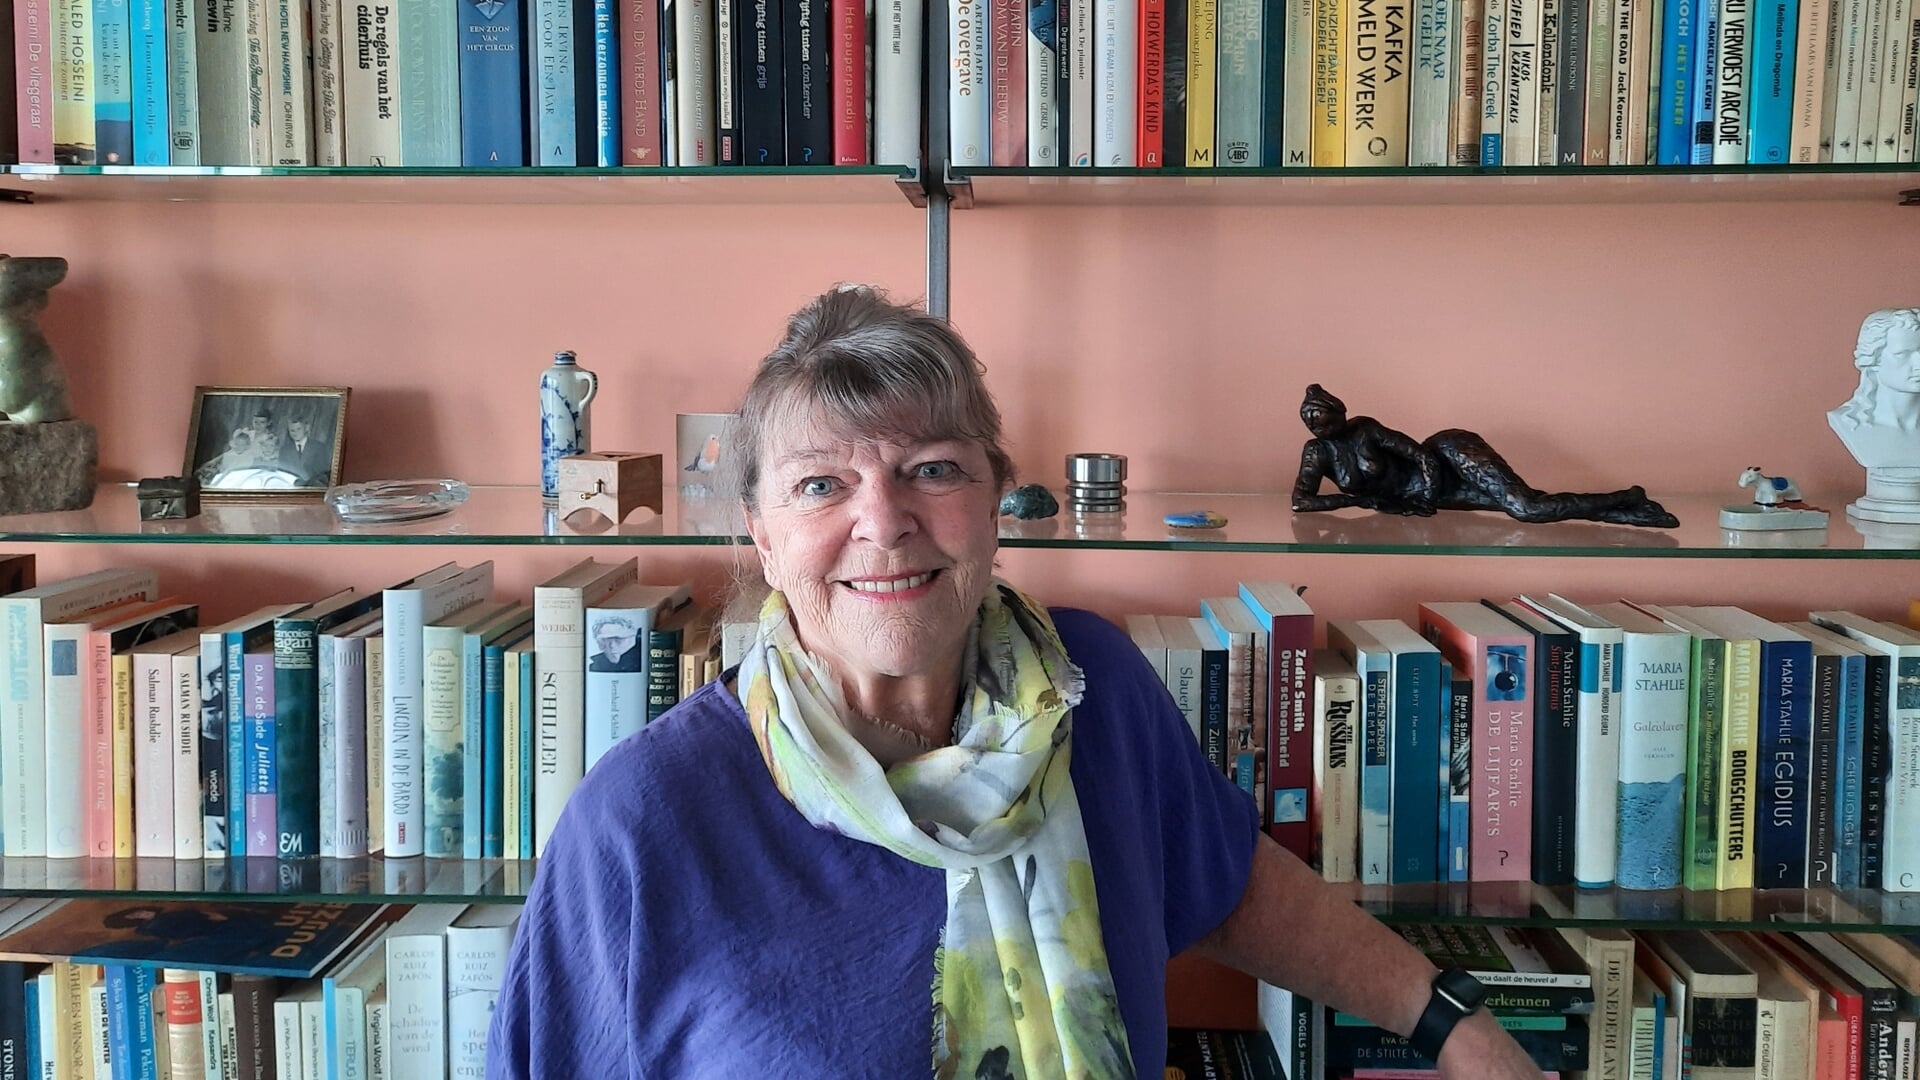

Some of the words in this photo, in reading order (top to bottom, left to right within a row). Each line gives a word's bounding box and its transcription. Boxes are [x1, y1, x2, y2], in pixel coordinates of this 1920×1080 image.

[280, 5, 288, 30] HOTEL
[375, 6, 389, 23] De
[486, 25, 510, 33] ZOON
[598, 14, 610, 33] Het
[844, 7, 855, 29] Het
[975, 4, 983, 50] ARTHUR
[1009, 8, 1022, 47] JAPIN
[1107, 19, 1115, 30] UIT
[1203, 9, 1214, 40] JONG
[1317, 1, 1326, 50] ANDERE
[1620, 11, 1629, 30] THE
[1775, 4, 1786, 37] Melinda
[59, 13, 68, 66] schitterende
[281, 31, 290, 51] NEW
[357, 5, 373, 69] ciderhuis
[373, 26, 390, 67] regels
[757, 30, 766, 63] tinten
[801, 29, 811, 61] tinten
[892, 24, 901, 39] WITTE
[892, 41, 901, 54] HART
[997, 22, 1007, 52] VAN
[1061, 27, 1068, 36] De
[1106, 34, 1115, 48] HET
[1384, 6, 1404, 83] KAFKA
[1420, 15, 1432, 68] GELUK
[1488, 15, 1501, 52] Zorba
[1776, 40, 1782, 50] en
[1911, 38, 1920, 55] VAN
[29, 43, 42, 61] De
[954, 20, 972, 96] overgave
[997, 56, 1008, 73] DE
[1106, 49, 1114, 69] RAAM
[1146, 11, 1160, 96] HOKWERDA'S
[1433, 36, 1446, 80] NAAR
[1568, 35, 1577, 91] KELLENDONK
[1618, 34, 1628, 64] ROAD
[1676, 44, 1686, 72] HET
[1706, 21, 1715, 76] MAKKELIJK
[1722, 19, 1745, 88] VERWOEST
[72, 36, 85, 101] HOSSEINI
[111, 65, 121, 94] bergen
[282, 51, 292, 96] HAMPSHIRE
[378, 70, 388, 94] van
[598, 39, 609, 96] verzonnen
[756, 65, 767, 89] grijs
[843, 33, 856, 130] pauperparadijs
[974, 53, 983, 84] JAPIN
[1040, 47, 1048, 97] SCHITTEREND
[1317, 54, 1325, 103] MENSEN
[1487, 54, 1500, 78] The
[1521, 51, 1531, 81] NIKOS
[1617, 71, 1627, 93] Jack
[1806, 68, 1815, 87] VAN
[1908, 56, 1917, 88] KOOTEN
[27, 67, 43, 128] vliegeraar
[60, 69, 68, 100] zonnen
[802, 64, 812, 119] donkerder
[997, 78, 1008, 123] LEEUW
[1355, 67, 1376, 130] WERK
[1485, 81, 1499, 119] Greek
[1509, 51, 1520, 124] KAZANTZAKIS
[1704, 79, 1713, 110] LEVEN
[379, 97, 391, 119] het
[599, 100, 611, 136] meisje
[1040, 103, 1048, 130] GEBREK
[1147, 102, 1159, 133] KIND
[1327, 88, 1337, 127] GELUK
[1674, 80, 1685, 125] DINER
[1719, 91, 1742, 146] ARCADIË
[1803, 90, 1815, 128] HAVANA
[1487, 136, 1495, 164] FABER
[540, 623, 576, 633] WERKE
[229, 644, 240, 670] Ward
[1280, 650, 1291, 685] Over
[1294, 650, 1306, 688] Zadie
[1563, 648, 1574, 685] Maria
[1639, 662, 1683, 674] MARIA
[1707, 658, 1715, 680] Maria
[1733, 643, 1751, 687] MARIA
[148, 669, 160, 703] Salman
[180, 673, 190, 710] SALMAN
[1209, 664, 1221, 702] Pauline
[1367, 684, 1376, 698] DE
[1548, 645, 1562, 711] Sint-Juttemis
[1634, 678, 1686, 691] STAHLIE
[1781, 659, 1793, 696] MARIA
[1823, 665, 1832, 697] MARIA
[255, 697, 266, 710] de
[610, 680, 619, 712] Bernhard
[1293, 690, 1305, 732] Smith
[1377, 678, 1387, 717] STEPHEN
[1460, 695, 1468, 720] Maria
[1562, 687, 1574, 728] Stahlie
[1706, 681, 1714, 708] Stahlie
[148, 706, 162, 743] Rushdie
[255, 712, 266, 739] Sade
[392, 695, 414, 743] LINCOLN
[541, 672, 557, 774] SCHILLER
[611, 714, 619, 740] Schlink
[1209, 703, 1221, 724] Slot
[1279, 687, 1290, 767] schoonheid
[1367, 704, 1375, 753] TEMPEL
[1488, 711, 1501, 737] DE
[1732, 692, 1749, 745] STAHLIE
[1778, 700, 1792, 744] STAHLIE
[1821, 698, 1830, 735] STAHLIE
[181, 713, 191, 755] RUSHDIE
[231, 725, 240, 738] De
[1326, 700, 1355, 769] RUSSIANS
[1376, 718, 1386, 758] SPENDER
[1509, 711, 1523, 753] Maria
[255, 743, 269, 793] Juliette
[394, 749, 411, 759] IN
[1909, 745, 1920, 789] Steenbeek
[209, 770, 219, 802] woede
[394, 765, 410, 777] DE
[1508, 758, 1522, 807] Stahlie
[392, 781, 411, 815] BARDO
[1484, 745, 1500, 837] LIJFARTS
[1728, 750, 1747, 861] BOOGSCHUTTERS
[1773, 751, 1794, 827] EGIDIUS
[403, 962, 427, 970] RUIZ
[457, 951, 496, 959] CARLOS
[465, 963, 488, 971] RUIZ
[1607, 960, 1620, 982] DE
[111, 978, 121, 1002] Sylvia
[1494, 974, 1512, 982] daalt
[1524, 976, 1549, 984] heuvel
[100, 993, 108, 1015] LEON
[138, 993, 148, 1042] Witteman
[102, 1017, 109, 1028] DE
[370, 1008, 382, 1045] Virginia
[1298, 1012, 1308, 1048] VOGELS
[72, 1021, 82, 1066] WINSOR
[208, 1030, 217, 1070] Kassandra
[1358, 1048, 1371, 1058] DE
[1377, 1048, 1408, 1058] STILTE
[1381, 1037, 1396, 1045] EVA
[45, 1061, 54, 1075] Het
[345, 1040, 356, 1078] TERUG
